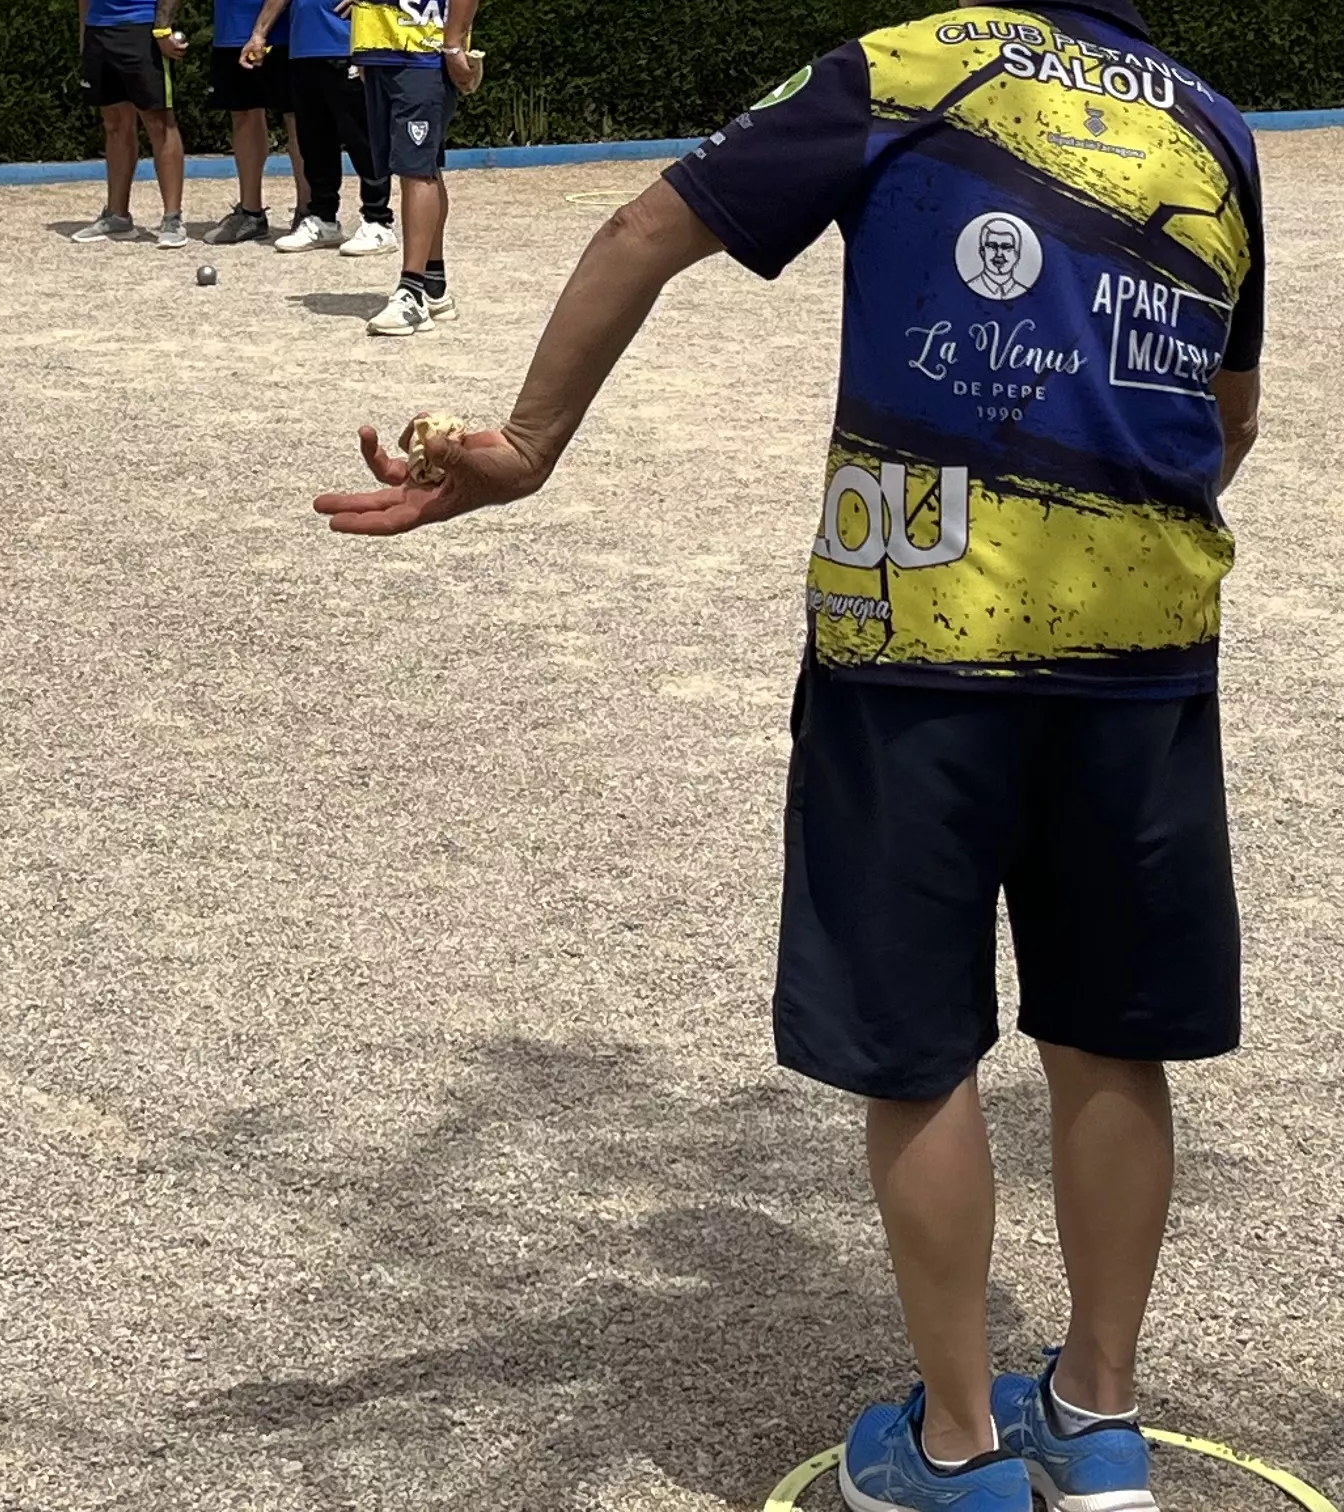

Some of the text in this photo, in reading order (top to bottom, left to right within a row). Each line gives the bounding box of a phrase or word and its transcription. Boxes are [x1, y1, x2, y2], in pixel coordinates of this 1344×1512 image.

[937, 20, 1045, 46] CLUB
[1001, 40, 1176, 109] SALOU
[1092, 272, 1182, 328] APART
[905, 318, 1087, 381] La Venus
[953, 380, 1047, 401] DE PEPE
[976, 405, 1024, 422] 1990
[811, 462, 969, 569] OU
